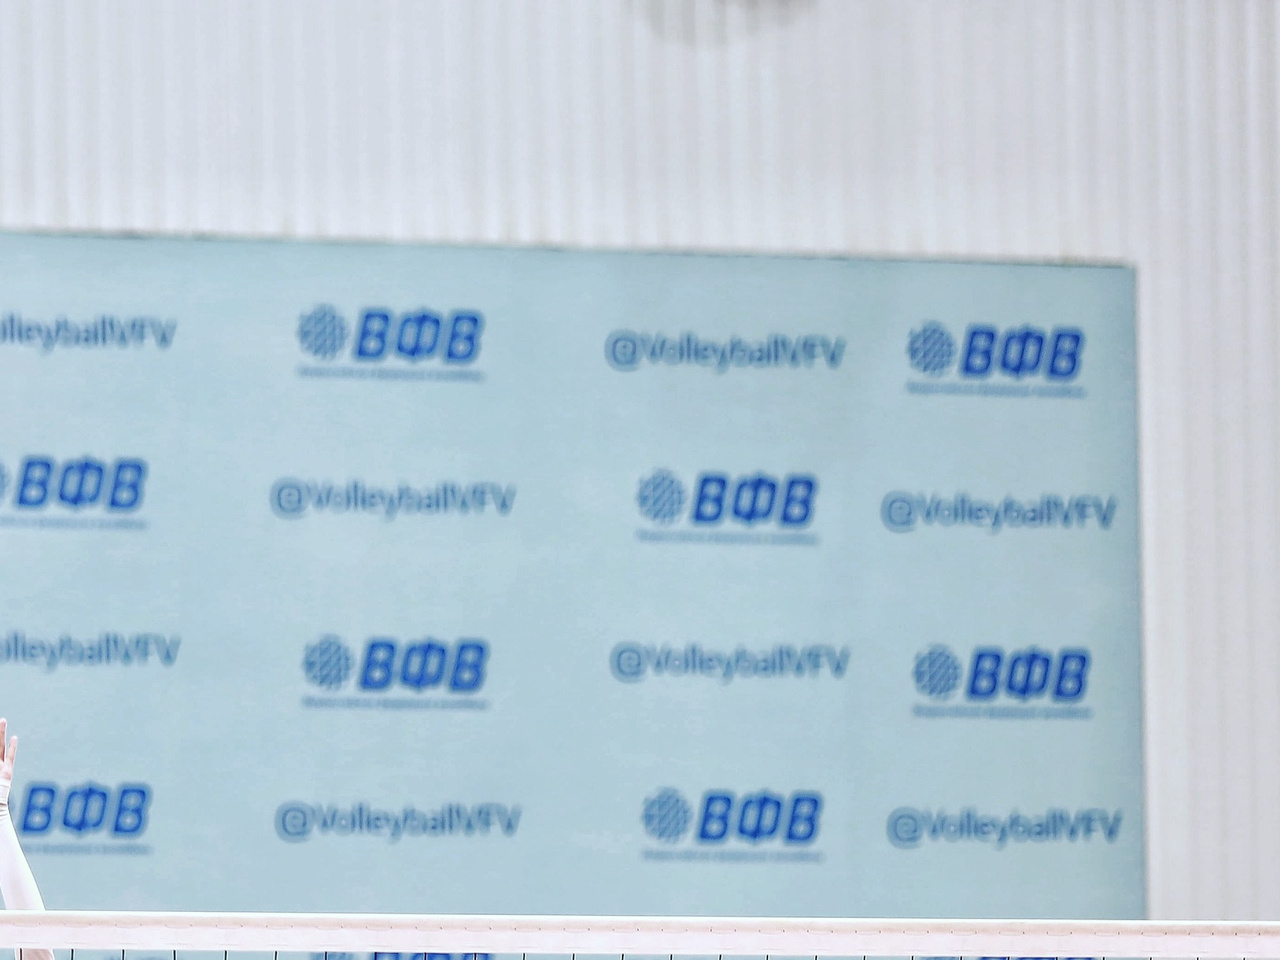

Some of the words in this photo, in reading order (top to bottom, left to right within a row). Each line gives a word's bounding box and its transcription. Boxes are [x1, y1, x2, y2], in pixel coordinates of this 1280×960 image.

[353, 309, 483, 364] ВФВ
[605, 331, 846, 373] @VolleyballVFV
[960, 325, 1085, 381] ВФВ
[15, 456, 147, 512] ВФВ
[270, 478, 516, 519] @VolleyballVFV
[691, 473, 817, 527] ВФВ
[881, 492, 1119, 533] @VolleyballVFV
[358, 639, 489, 693] ВФВ
[610, 643, 851, 683] @VolleyballVFV
[966, 648, 1090, 703] ВФВ
[18, 783, 151, 837] ВФВ
[275, 803, 521, 843] @VolleyballVFV
[696, 791, 822, 844] ВФВ
[887, 808, 1123, 849] @VolleyballVFV
